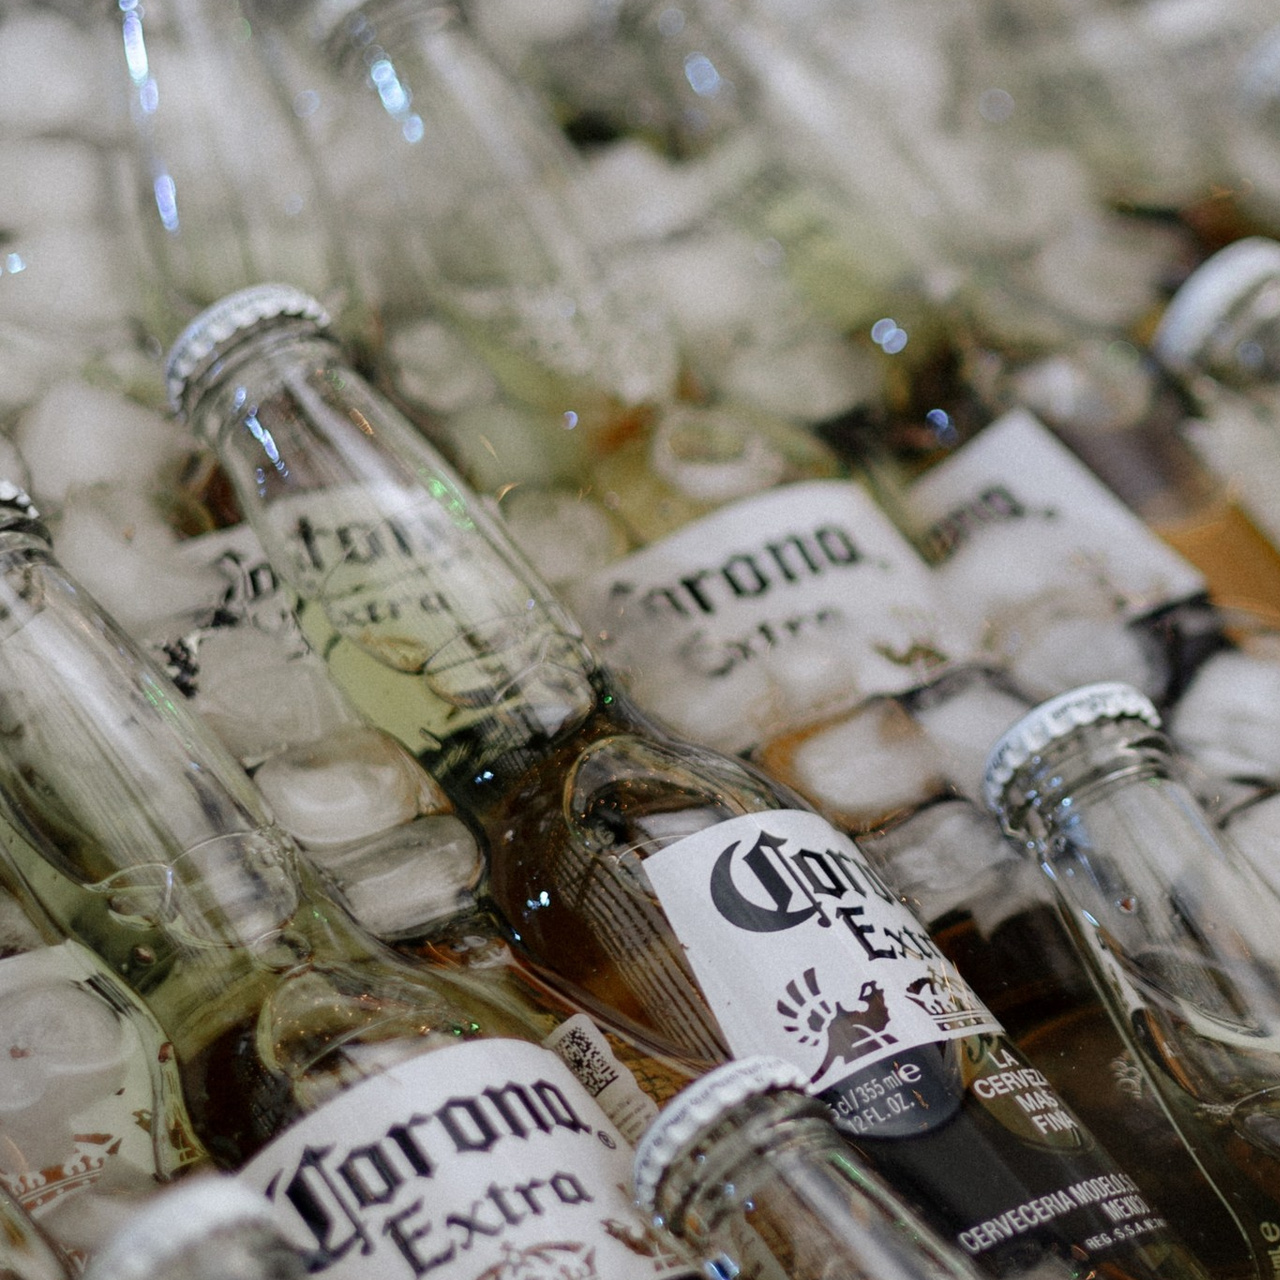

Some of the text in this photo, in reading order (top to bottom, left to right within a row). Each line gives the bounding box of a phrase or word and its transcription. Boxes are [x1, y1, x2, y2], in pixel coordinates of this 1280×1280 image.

[988, 1048, 1020, 1070] LA
[973, 1068, 1052, 1100] CERVEZ
[957, 1189, 1078, 1255] CERVECERIA
